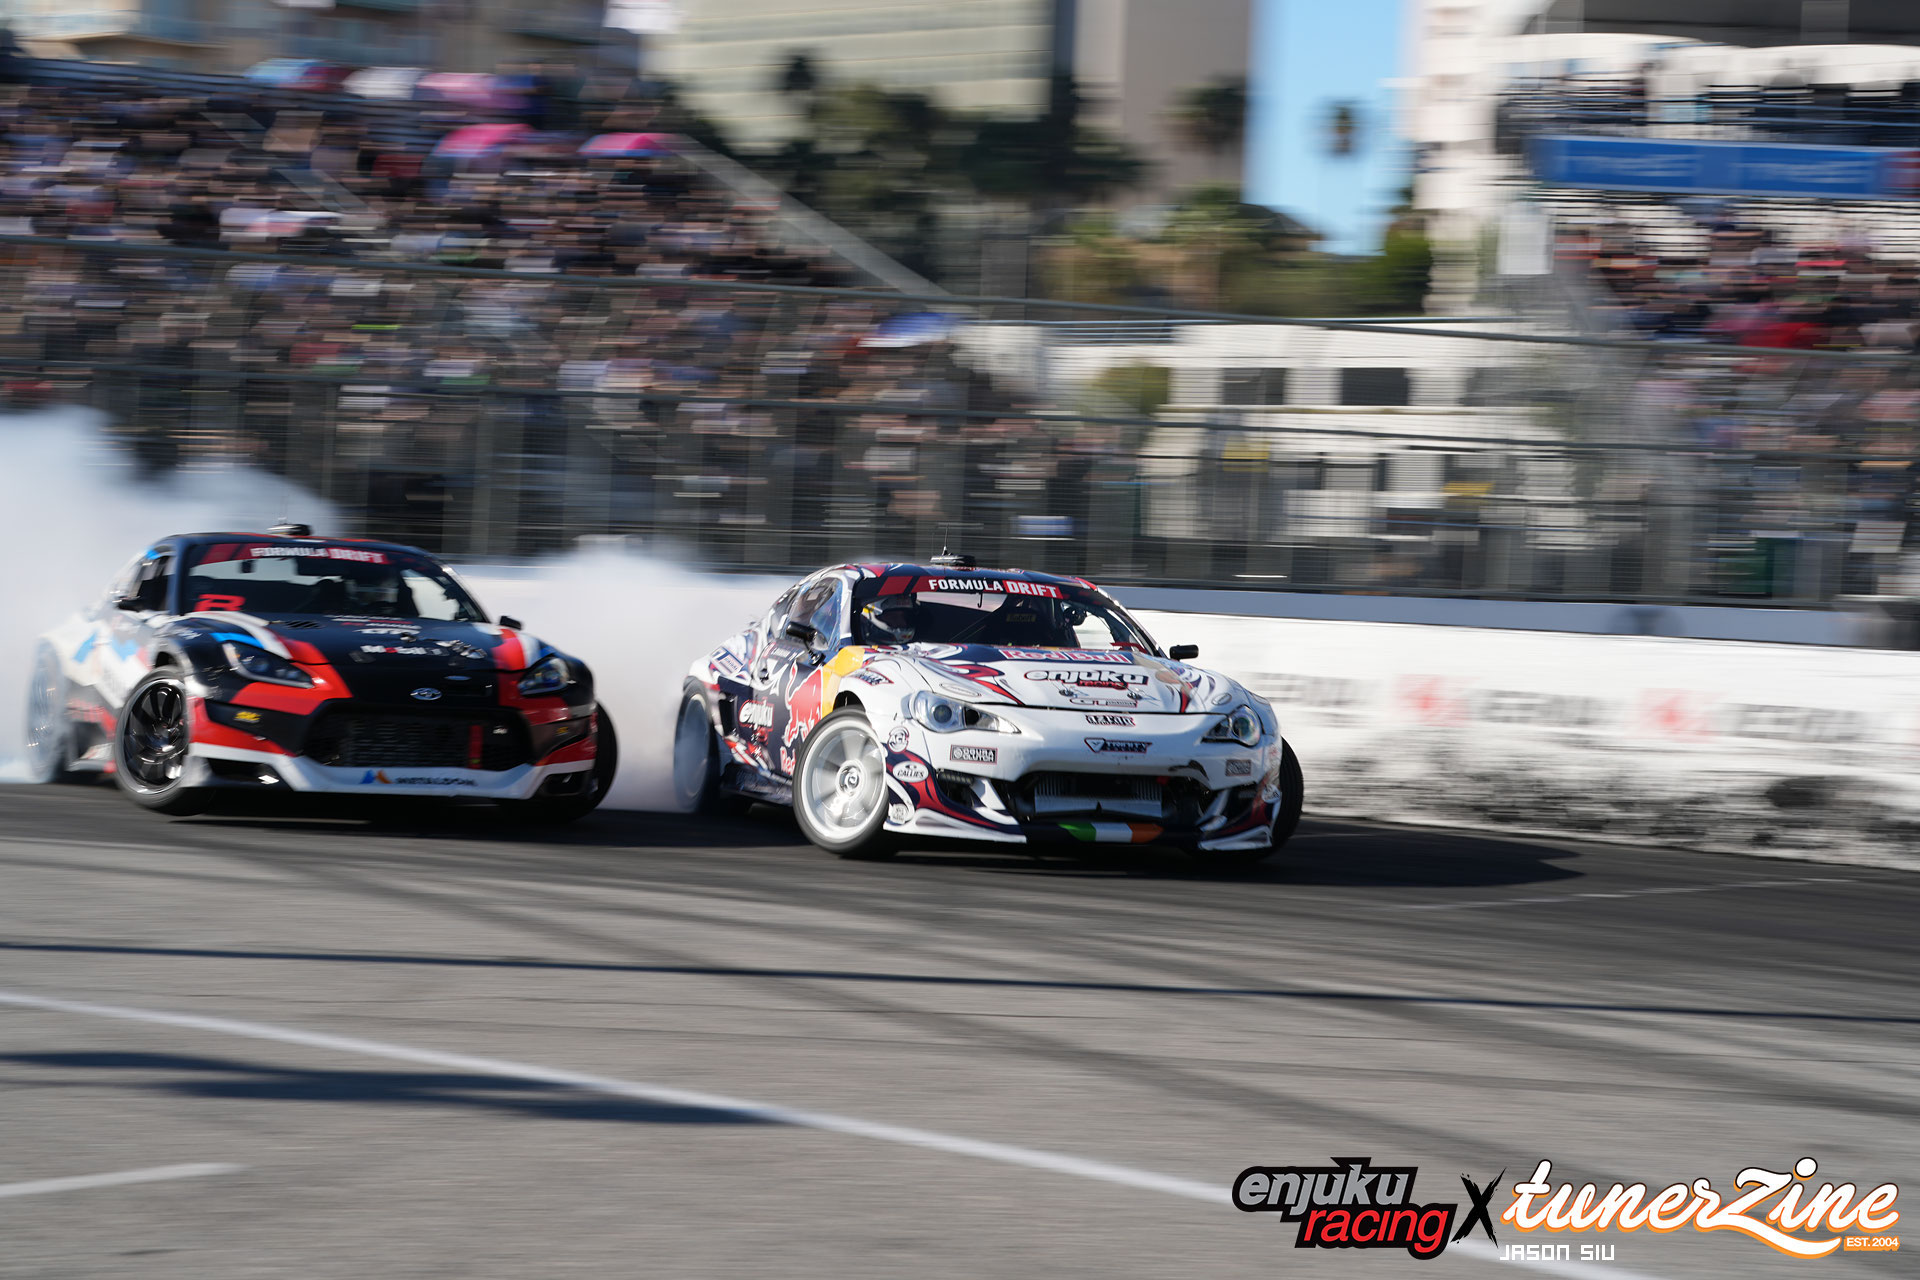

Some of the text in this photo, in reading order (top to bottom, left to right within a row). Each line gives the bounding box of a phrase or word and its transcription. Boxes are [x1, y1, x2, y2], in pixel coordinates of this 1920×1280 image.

[250, 547, 384, 563] FORMULA DRIFT
[928, 579, 1057, 598] FORMULA DRIFT
[360, 645, 427, 655] Mobil
[999, 649, 1134, 665] Red Bull
[1025, 670, 1148, 685] enjuku
